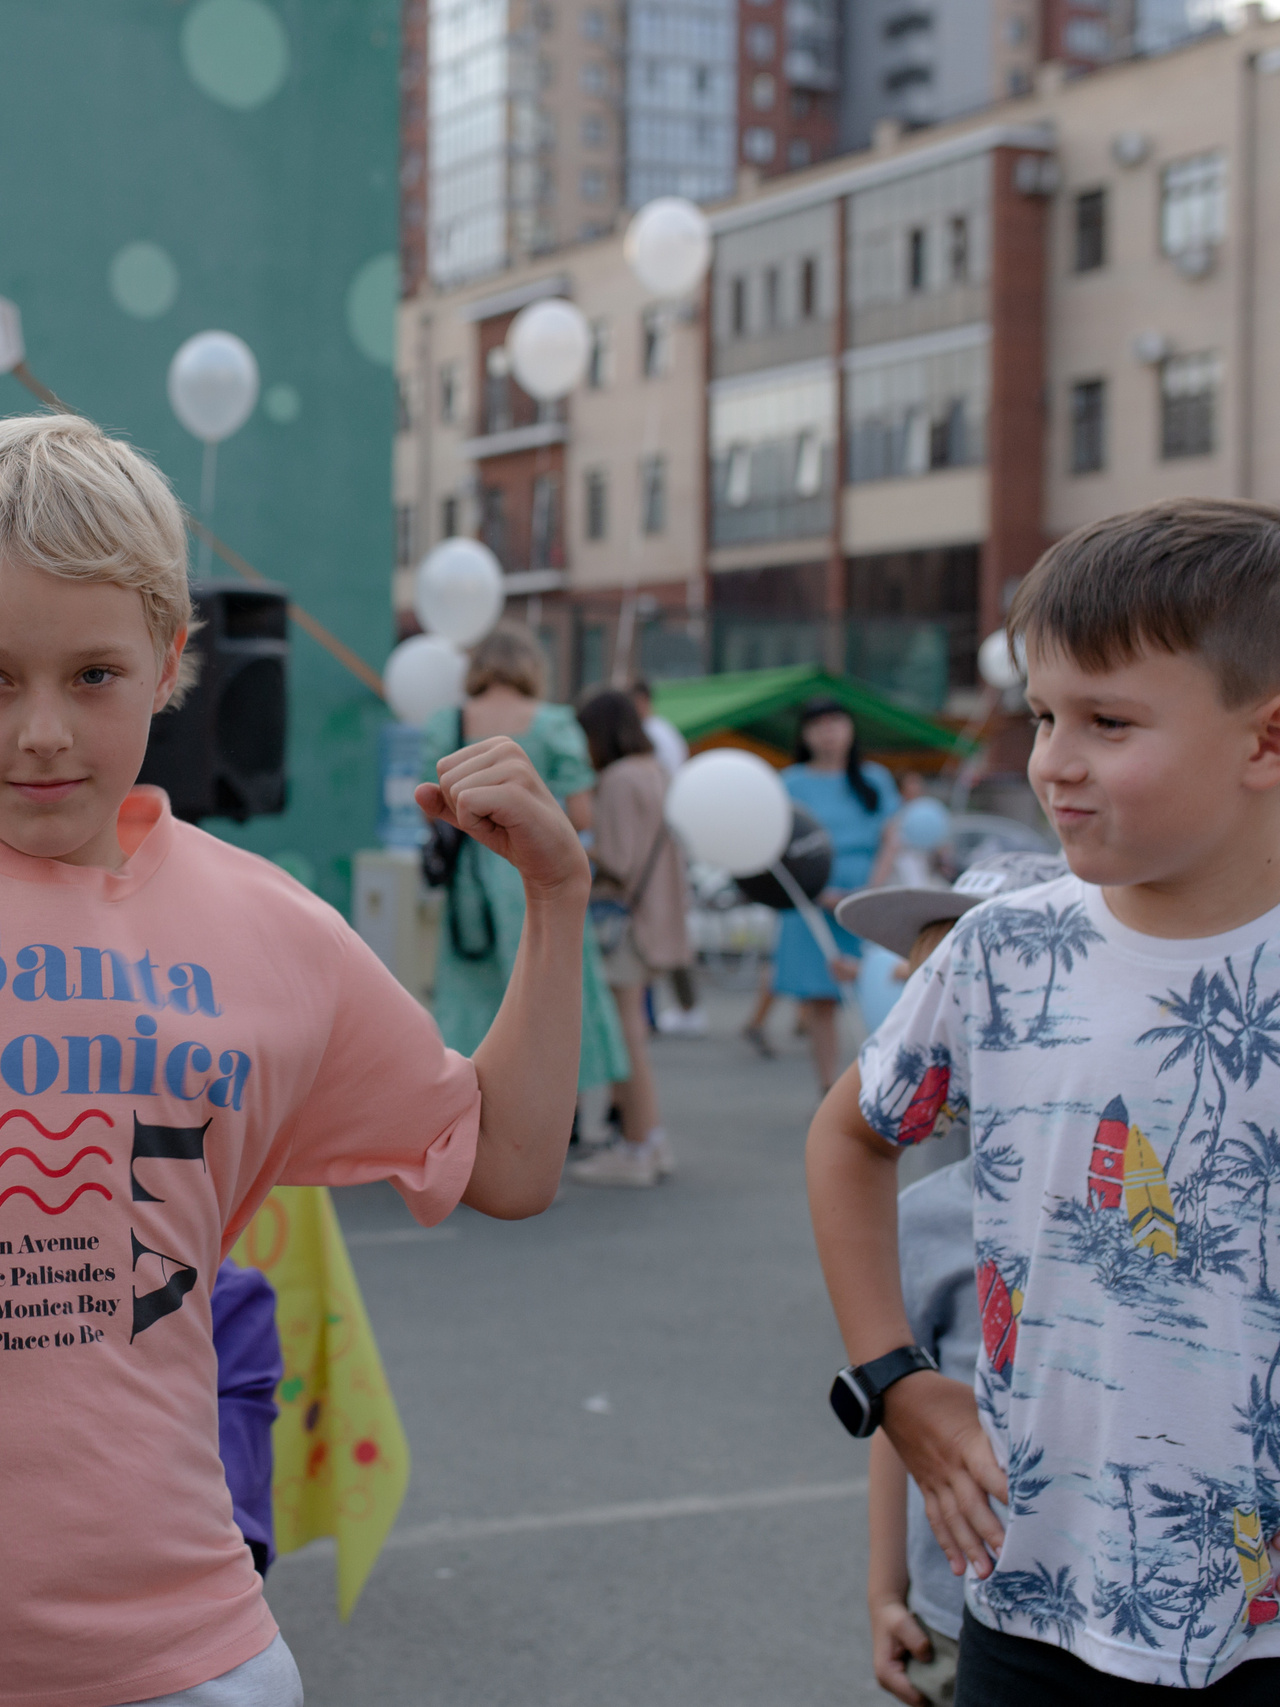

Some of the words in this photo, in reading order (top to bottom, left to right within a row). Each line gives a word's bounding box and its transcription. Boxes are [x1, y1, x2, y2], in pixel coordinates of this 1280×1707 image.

[129, 1109, 214, 1345] LA
[17, 1234, 100, 1255] Avenue
[9, 1263, 116, 1287] Palisades
[76, 1294, 121, 1317] Bay
[54, 1329, 75, 1347] to
[78, 1324, 105, 1344] Be
